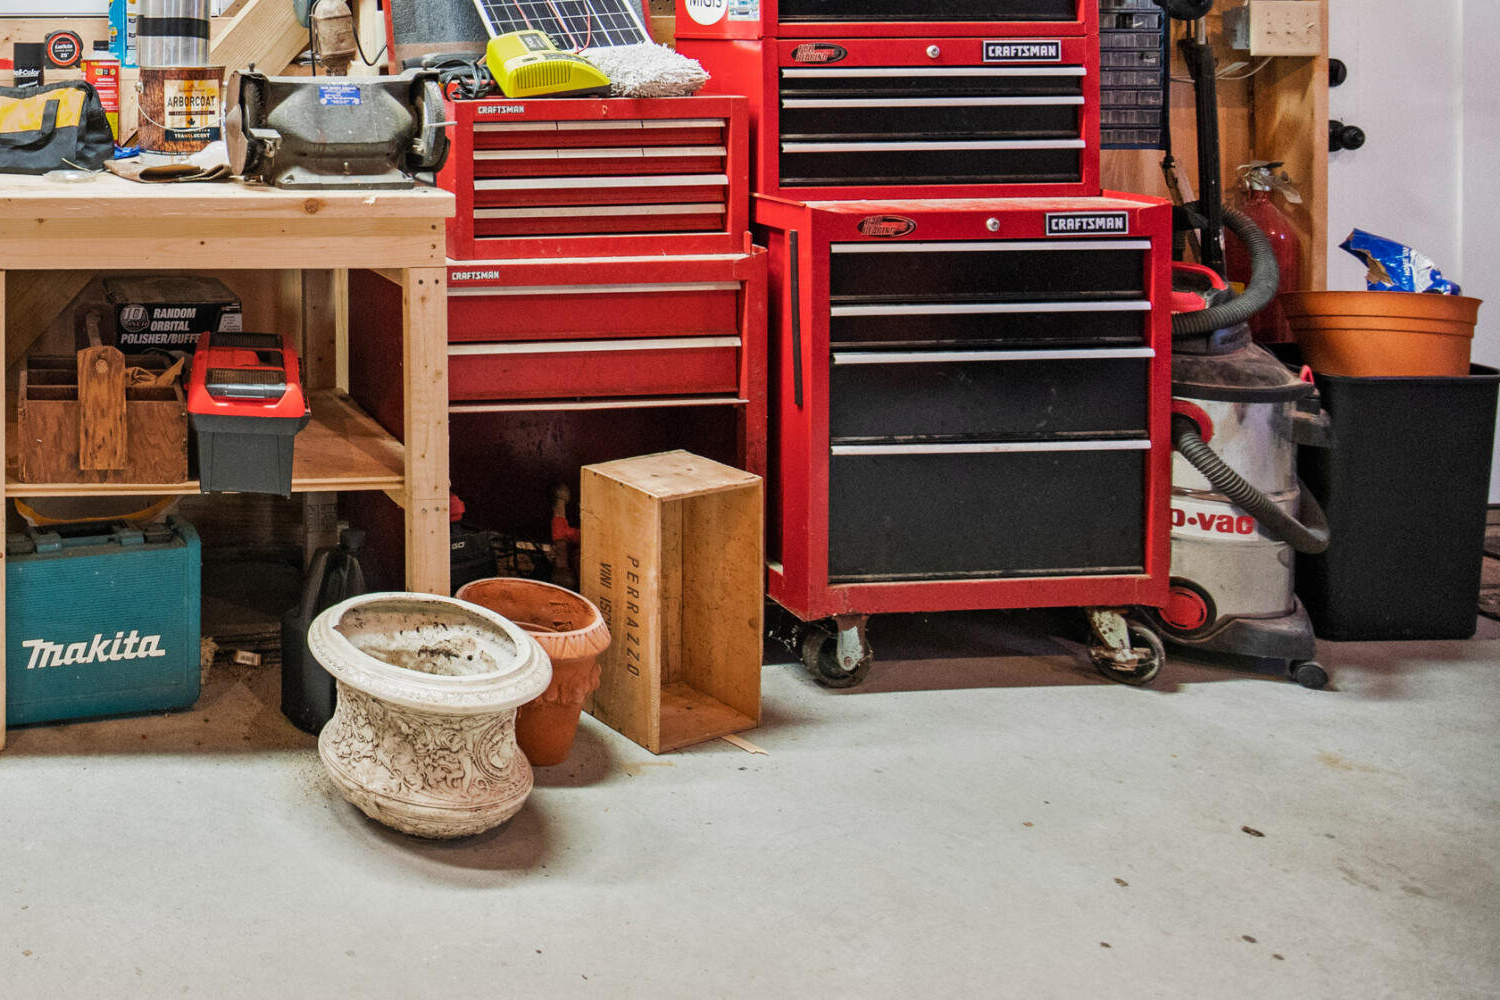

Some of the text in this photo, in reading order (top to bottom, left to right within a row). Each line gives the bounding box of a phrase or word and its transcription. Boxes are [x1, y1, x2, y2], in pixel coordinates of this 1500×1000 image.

[987, 44, 1057, 57] CRAFTSMAN
[167, 96, 216, 107] ARBORCOAT
[477, 105, 525, 115] CRAFTSMAN
[1050, 216, 1125, 232] CRAFTSMAN
[451, 270, 501, 280] CRAFTSMAN
[152, 307, 197, 319] RANDOM
[150, 320, 191, 332] ORBITAL
[600, 561, 613, 589] VINI
[626, 554, 640, 678] PERRAZZO
